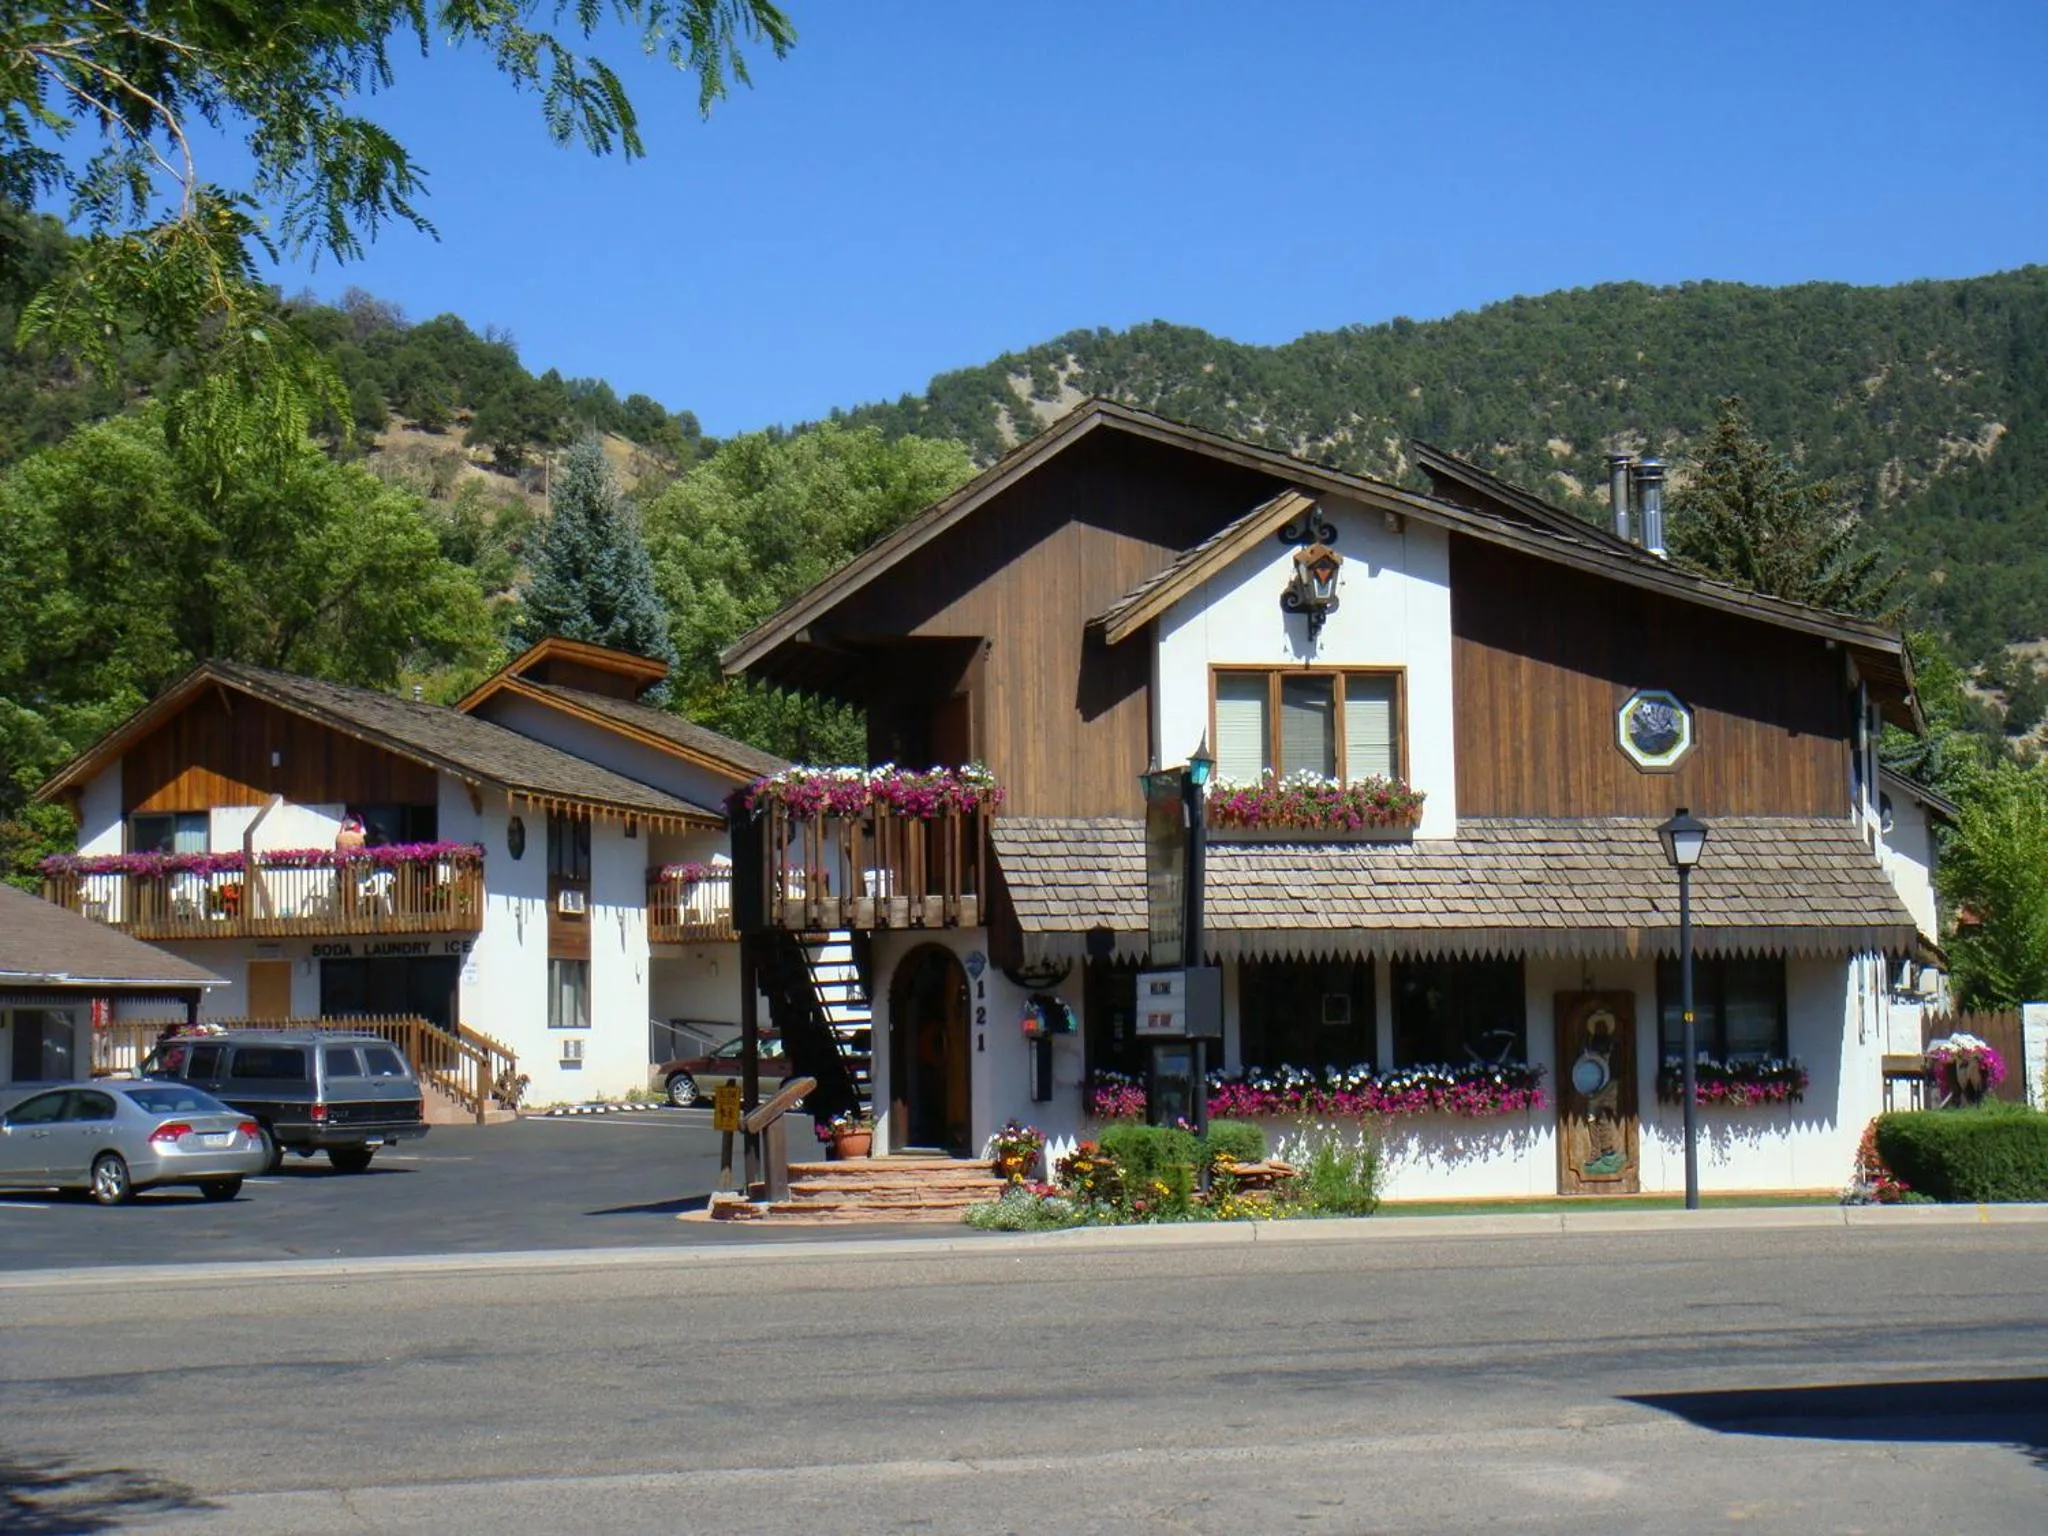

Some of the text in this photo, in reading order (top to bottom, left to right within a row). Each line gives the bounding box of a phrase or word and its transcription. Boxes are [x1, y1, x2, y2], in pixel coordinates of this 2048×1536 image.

[312, 940, 472, 957] SODA LAUNDRY ICE
